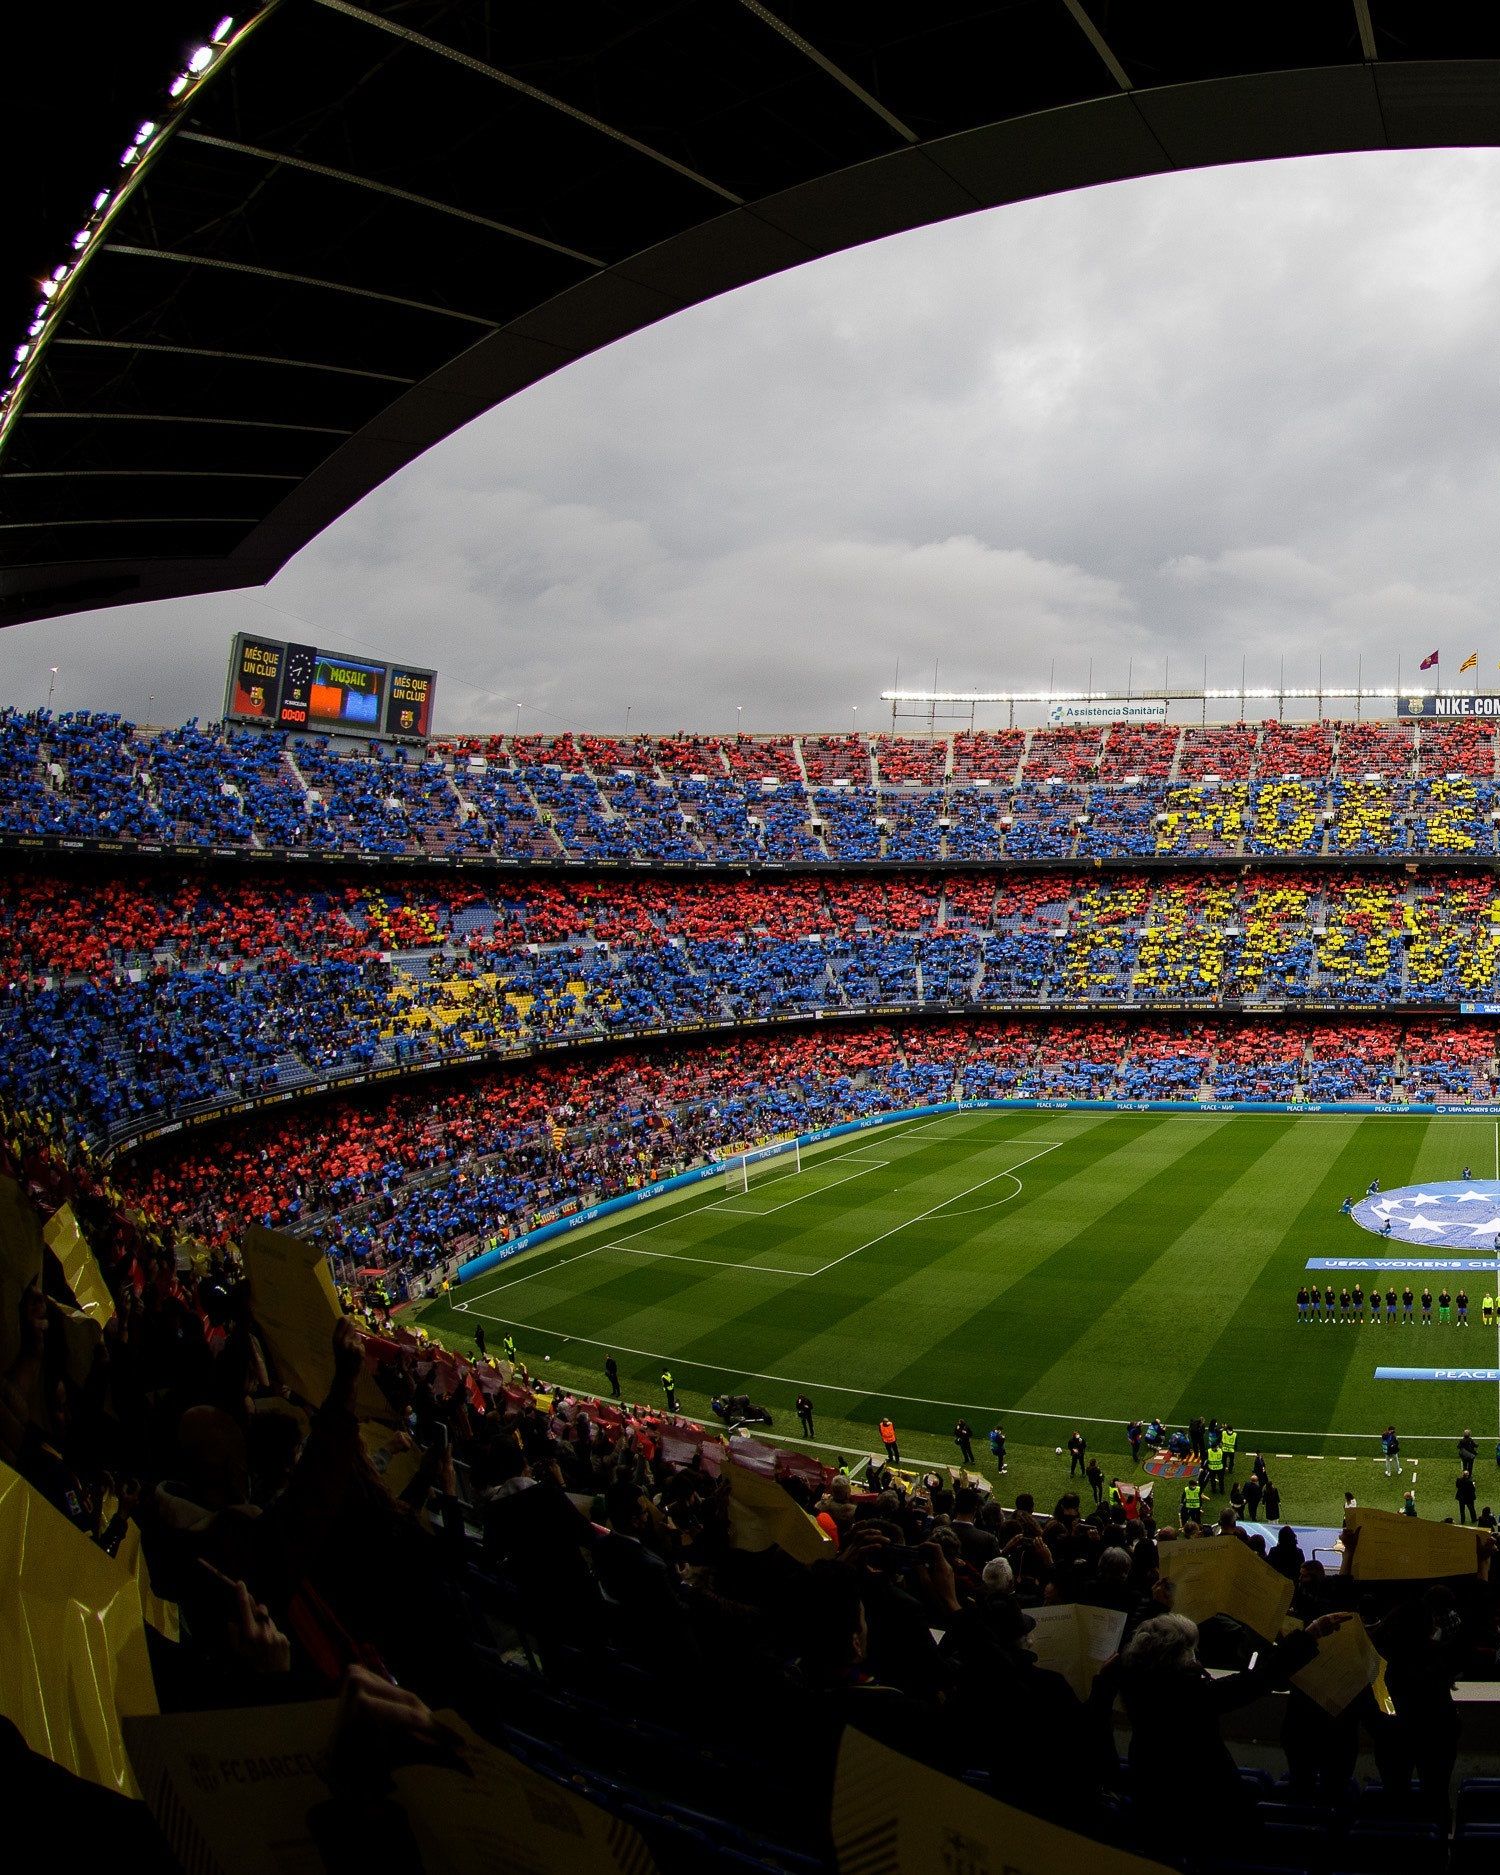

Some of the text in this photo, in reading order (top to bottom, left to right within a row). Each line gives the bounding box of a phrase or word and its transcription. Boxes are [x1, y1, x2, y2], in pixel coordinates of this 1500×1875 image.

[244, 647, 279, 665] MÉS QUE
[243, 664, 277, 678] UN CLUB
[330, 667, 366, 686] MOSAIC
[394, 675, 428, 690] MÉS QUE
[393, 689, 426, 702] UN CLUB
[281, 708, 306, 722] 00:00
[1066, 708, 1121, 717] Assistència
[1325, 1259, 1369, 1269] UEFA
[1374, 1259, 1462, 1269] WOMEN'S
[1434, 1369, 1499, 1380] PEACE
[219, 1758, 244, 1783] FC
